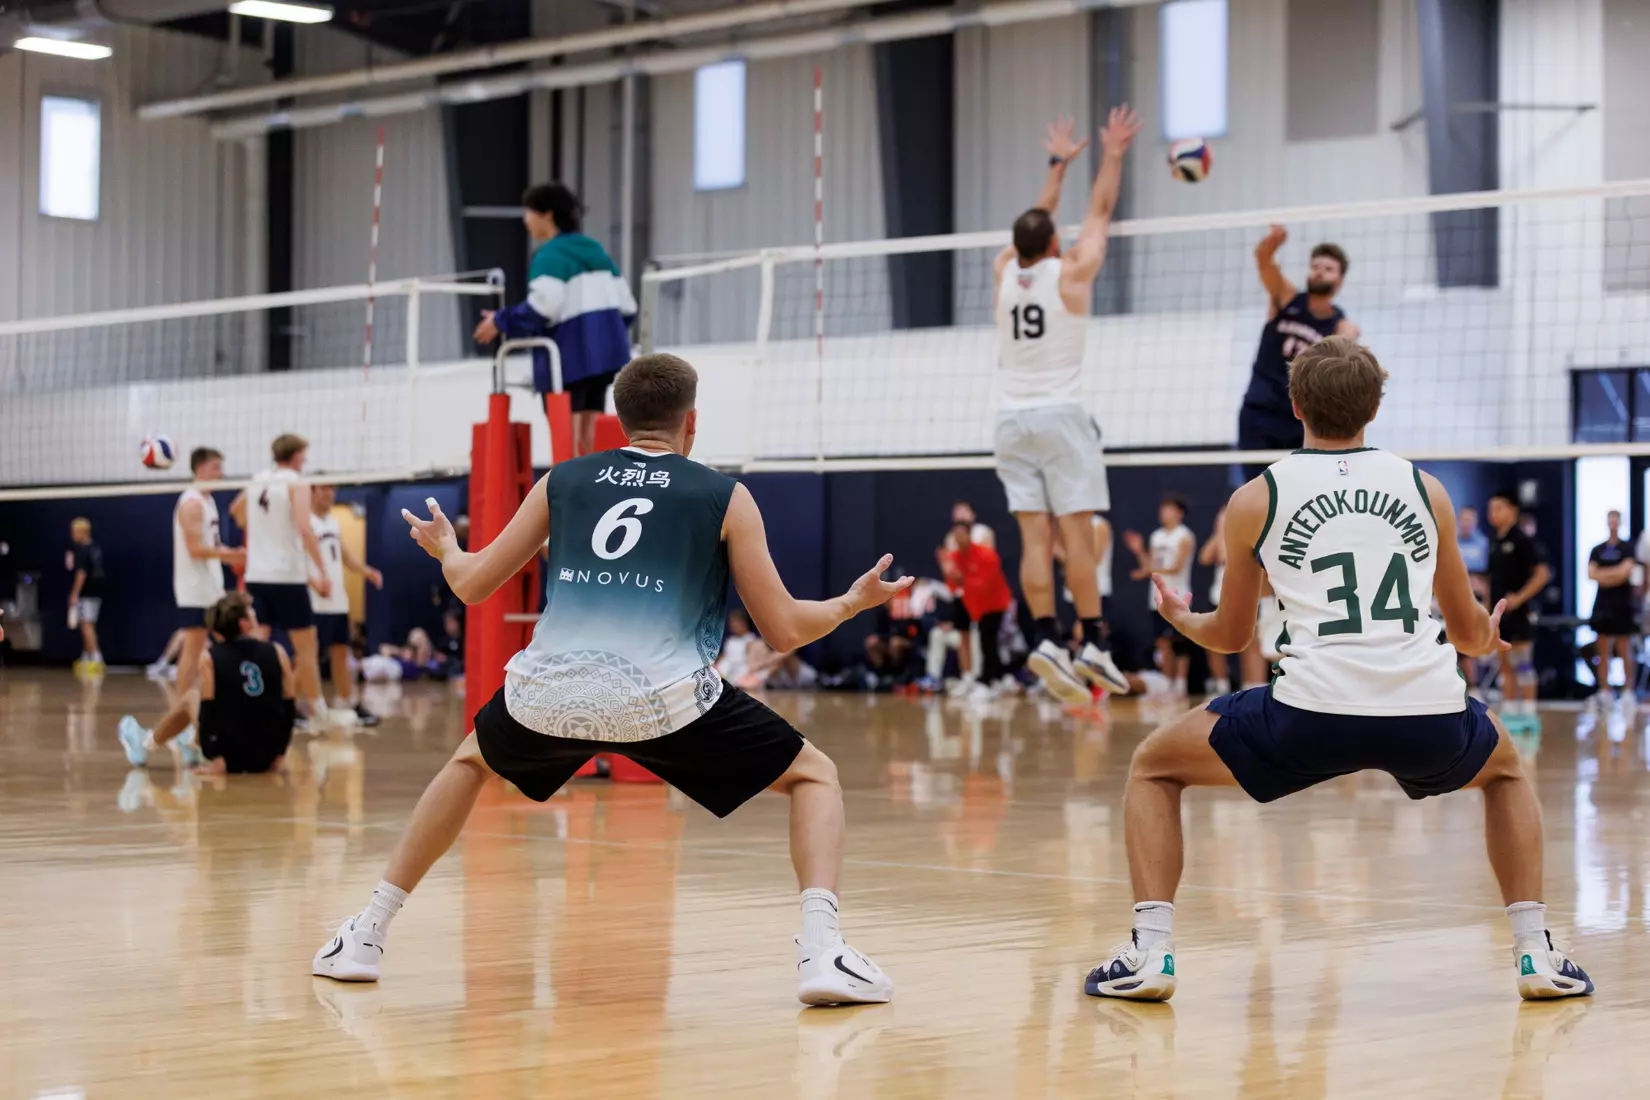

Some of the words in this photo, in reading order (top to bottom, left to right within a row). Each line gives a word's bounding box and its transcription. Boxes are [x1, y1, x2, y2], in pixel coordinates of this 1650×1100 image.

[1010, 303, 1045, 340] 19
[595, 466, 671, 488] 火烈鸟
[258, 489, 270, 514] 4
[591, 497, 654, 560] 6
[1278, 489, 1430, 570] ANTETOKOUNMPO
[576, 570, 664, 593] NOVUS
[1310, 552, 1419, 636] 34
[239, 660, 265, 697] 3
